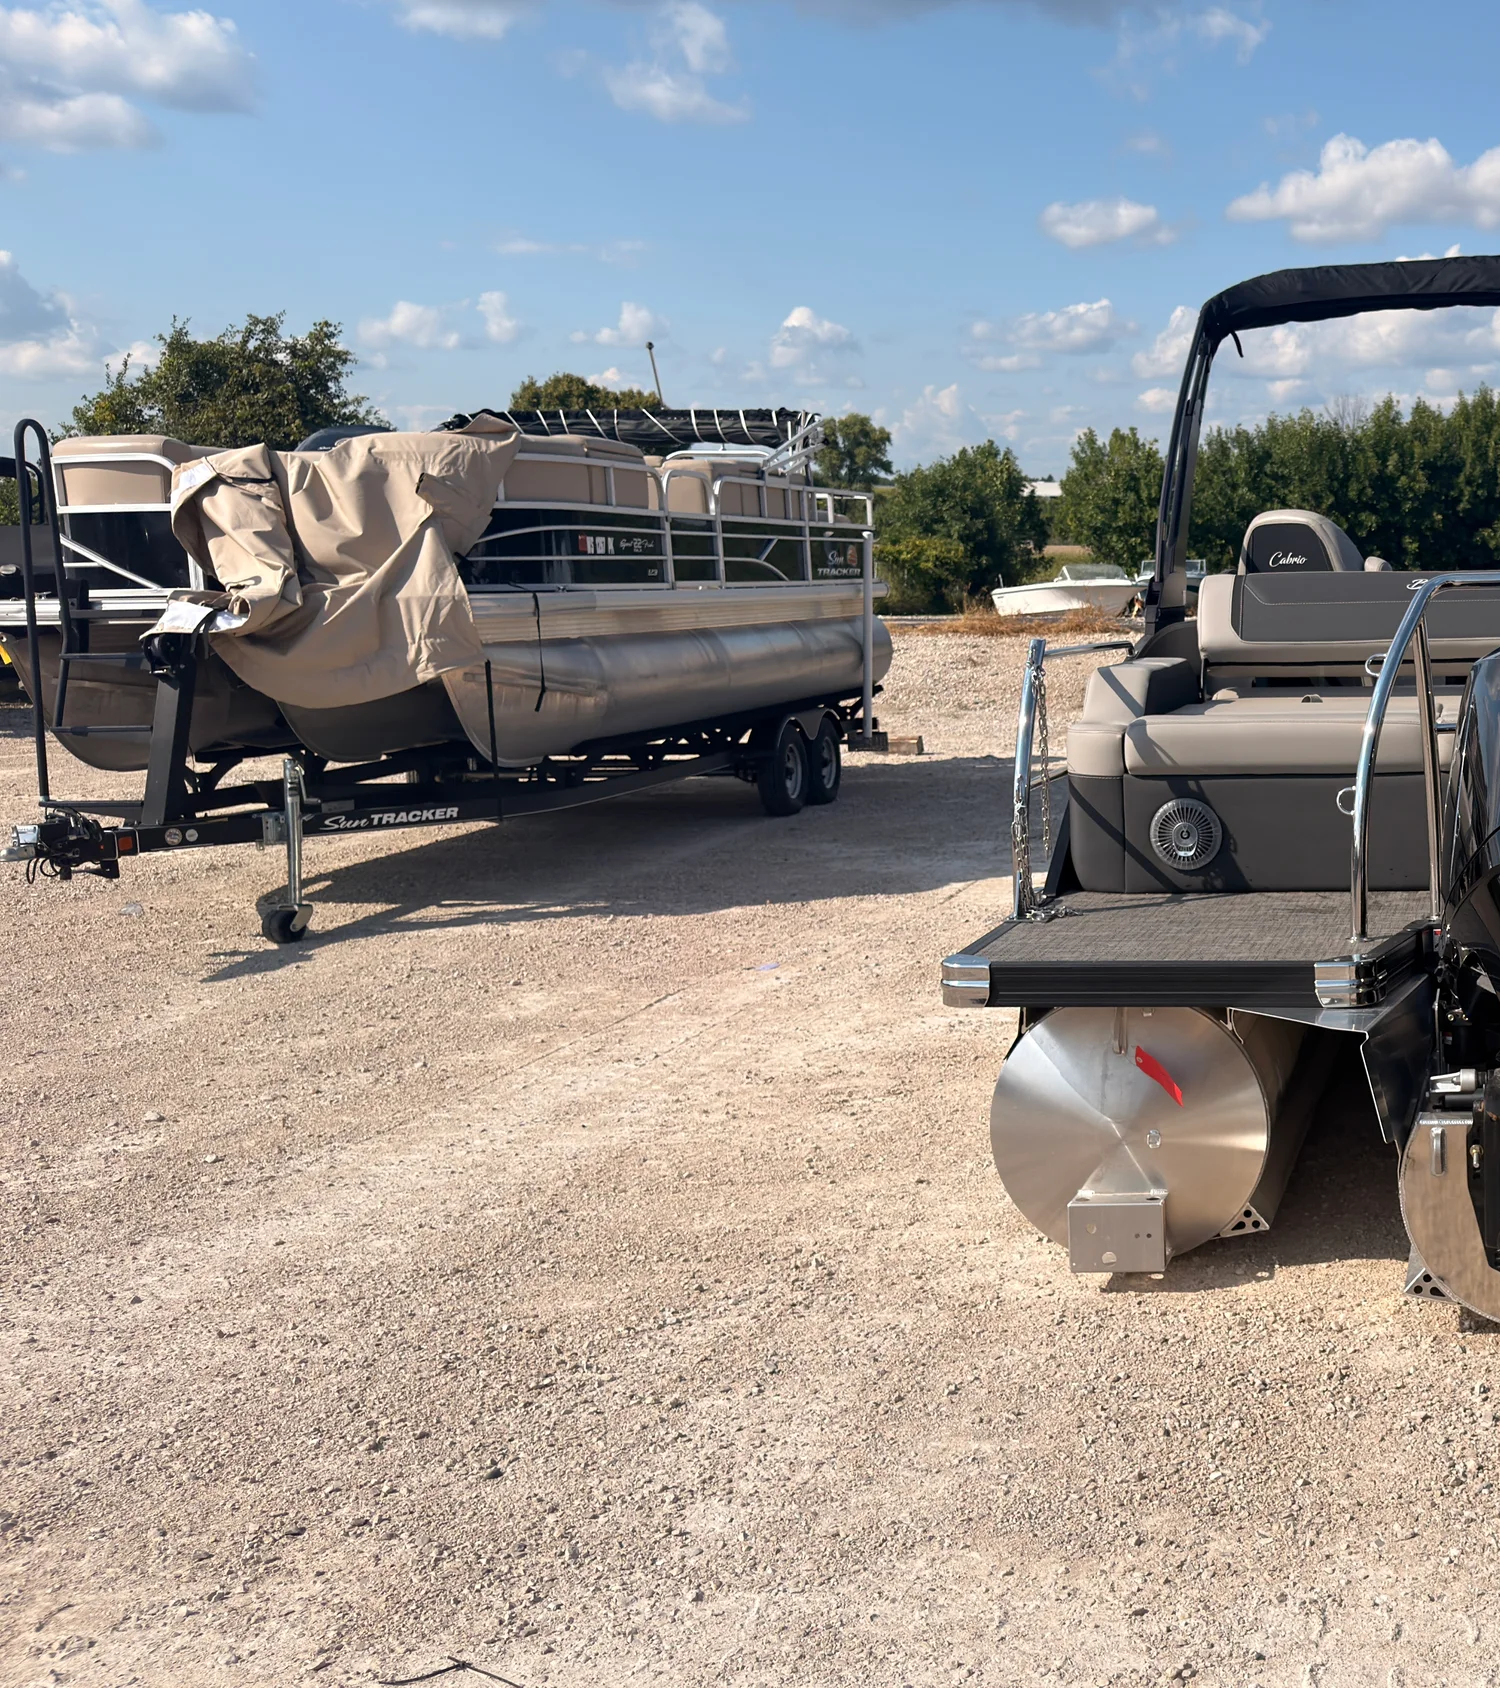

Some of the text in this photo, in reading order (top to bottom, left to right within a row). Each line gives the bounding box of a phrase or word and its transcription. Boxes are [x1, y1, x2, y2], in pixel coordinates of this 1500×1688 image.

[1268, 551, 1308, 568] Cabrio
[817, 567, 861, 576] TRACKER
[320, 807, 459, 830] Sun TRACKER
